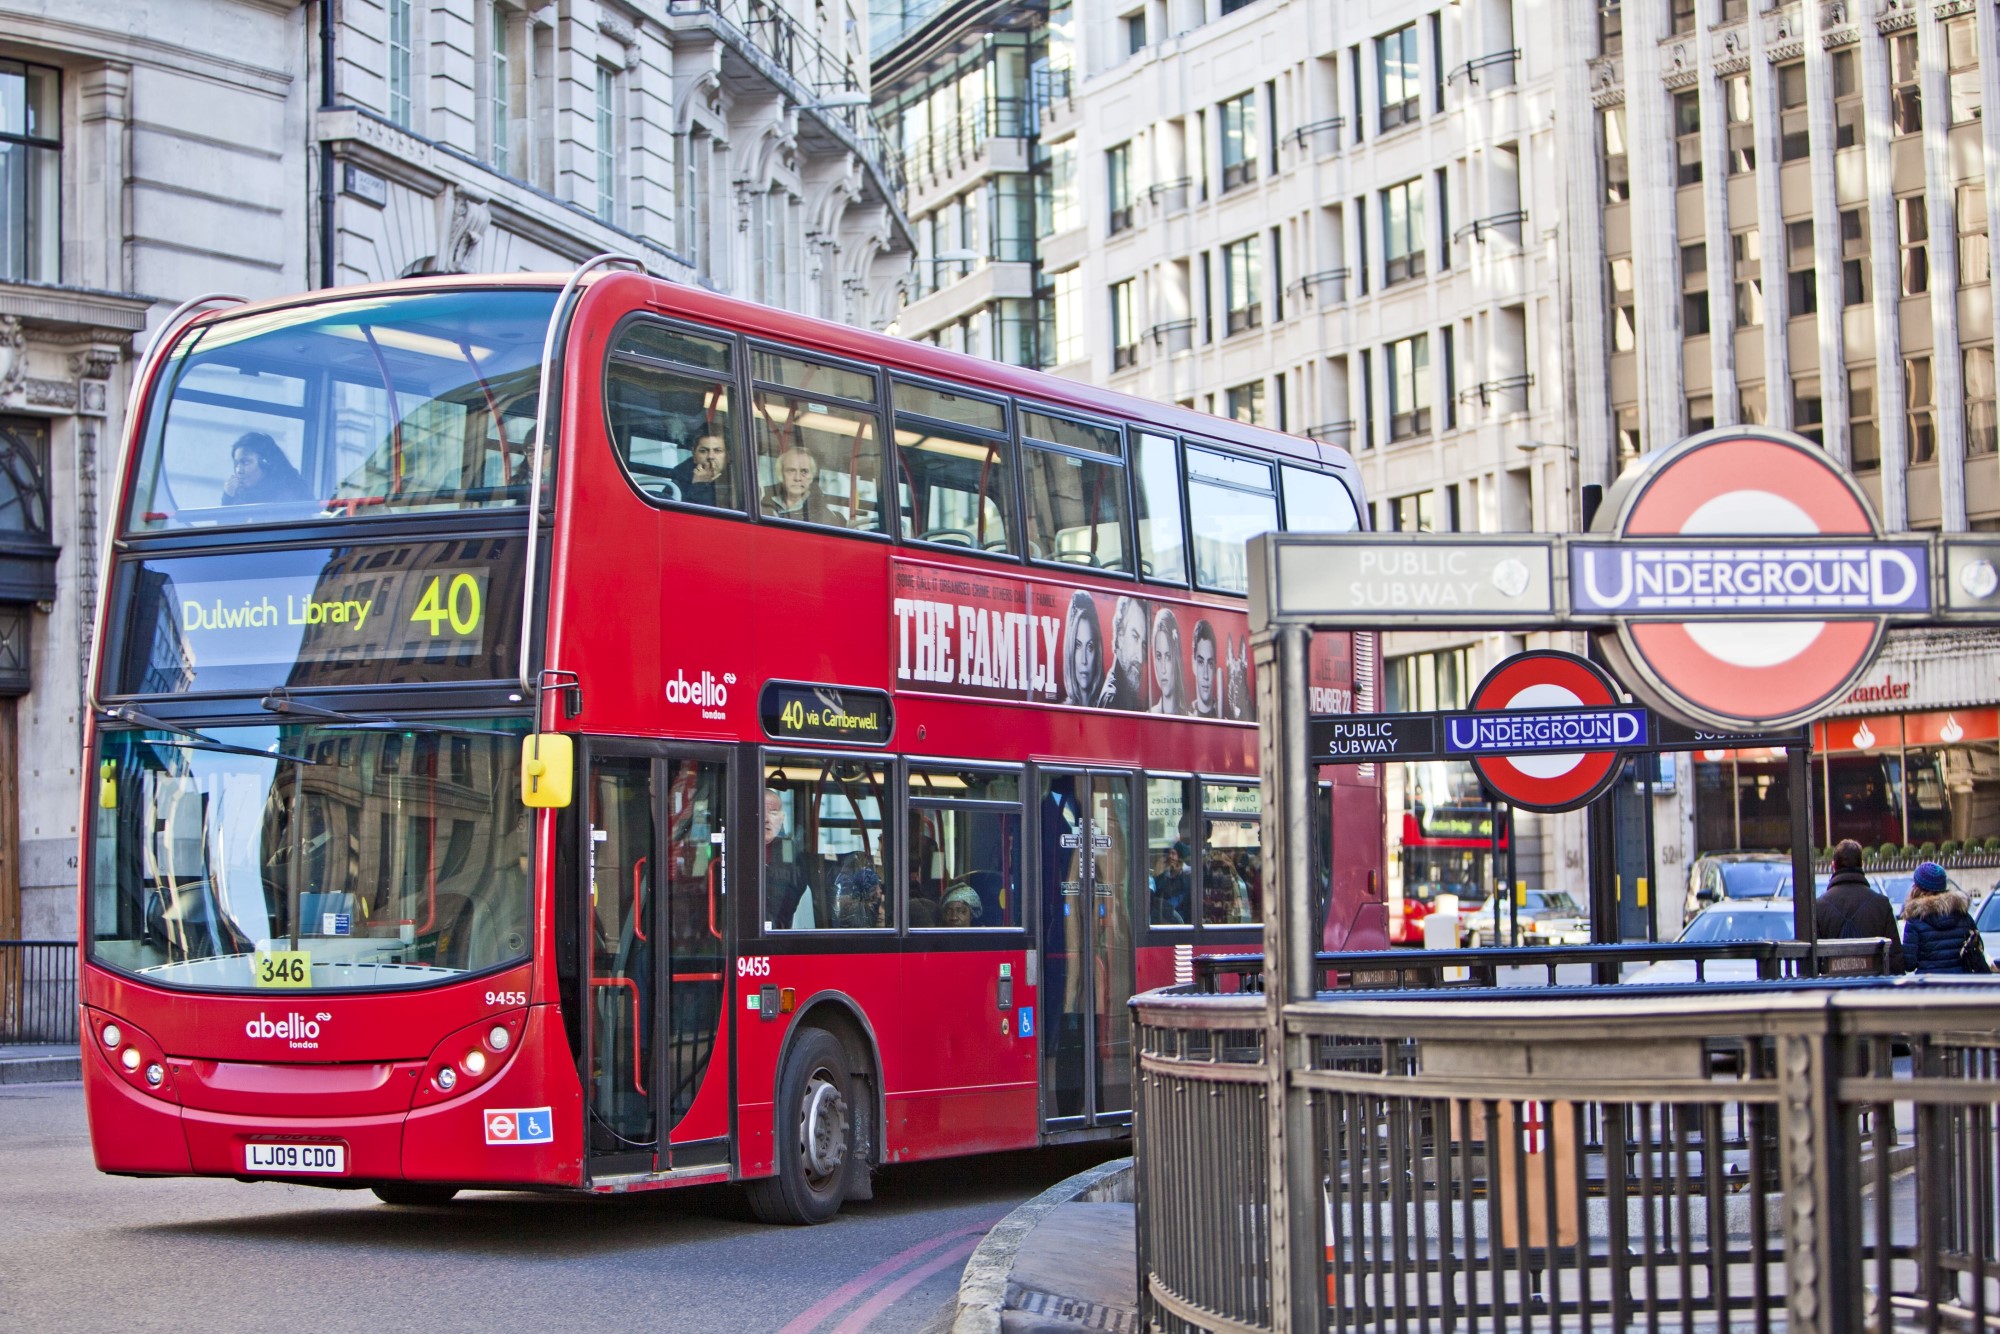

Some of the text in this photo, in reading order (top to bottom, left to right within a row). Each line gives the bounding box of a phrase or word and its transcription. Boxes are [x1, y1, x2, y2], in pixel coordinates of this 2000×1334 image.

[1359, 551, 1468, 575] PUBLIC
[1583, 549, 1918, 609] UNDERGROUND
[411, 573, 481, 636] 40
[1350, 581, 1479, 606] SUBWAY
[183, 594, 373, 631] Dulwich Library
[893, 598, 1061, 694] THE FAMILY
[665, 668, 728, 707] abellio
[1842, 674, 1911, 704] tander
[1342, 690, 1351, 714] 22
[702, 708, 726, 721] london
[781, 700, 878, 730] 40 via Camberwell
[1334, 722, 1393, 738] PUBLIC
[1451, 712, 1640, 749] UNDERGROUND
[1329, 738, 1398, 754] SUBWAY
[67, 856, 78, 868] 42
[1662, 845, 1676, 866] 52
[262, 958, 304, 982] 346
[737, 956, 770, 977] 9455
[1356, 969, 1384, 983] MONUMENT
[485, 991, 526, 1005] 9455
[245, 1012, 320, 1039] abellio
[289, 1040, 319, 1049] london
[252, 1146, 336, 1167] LJ09 CDO
